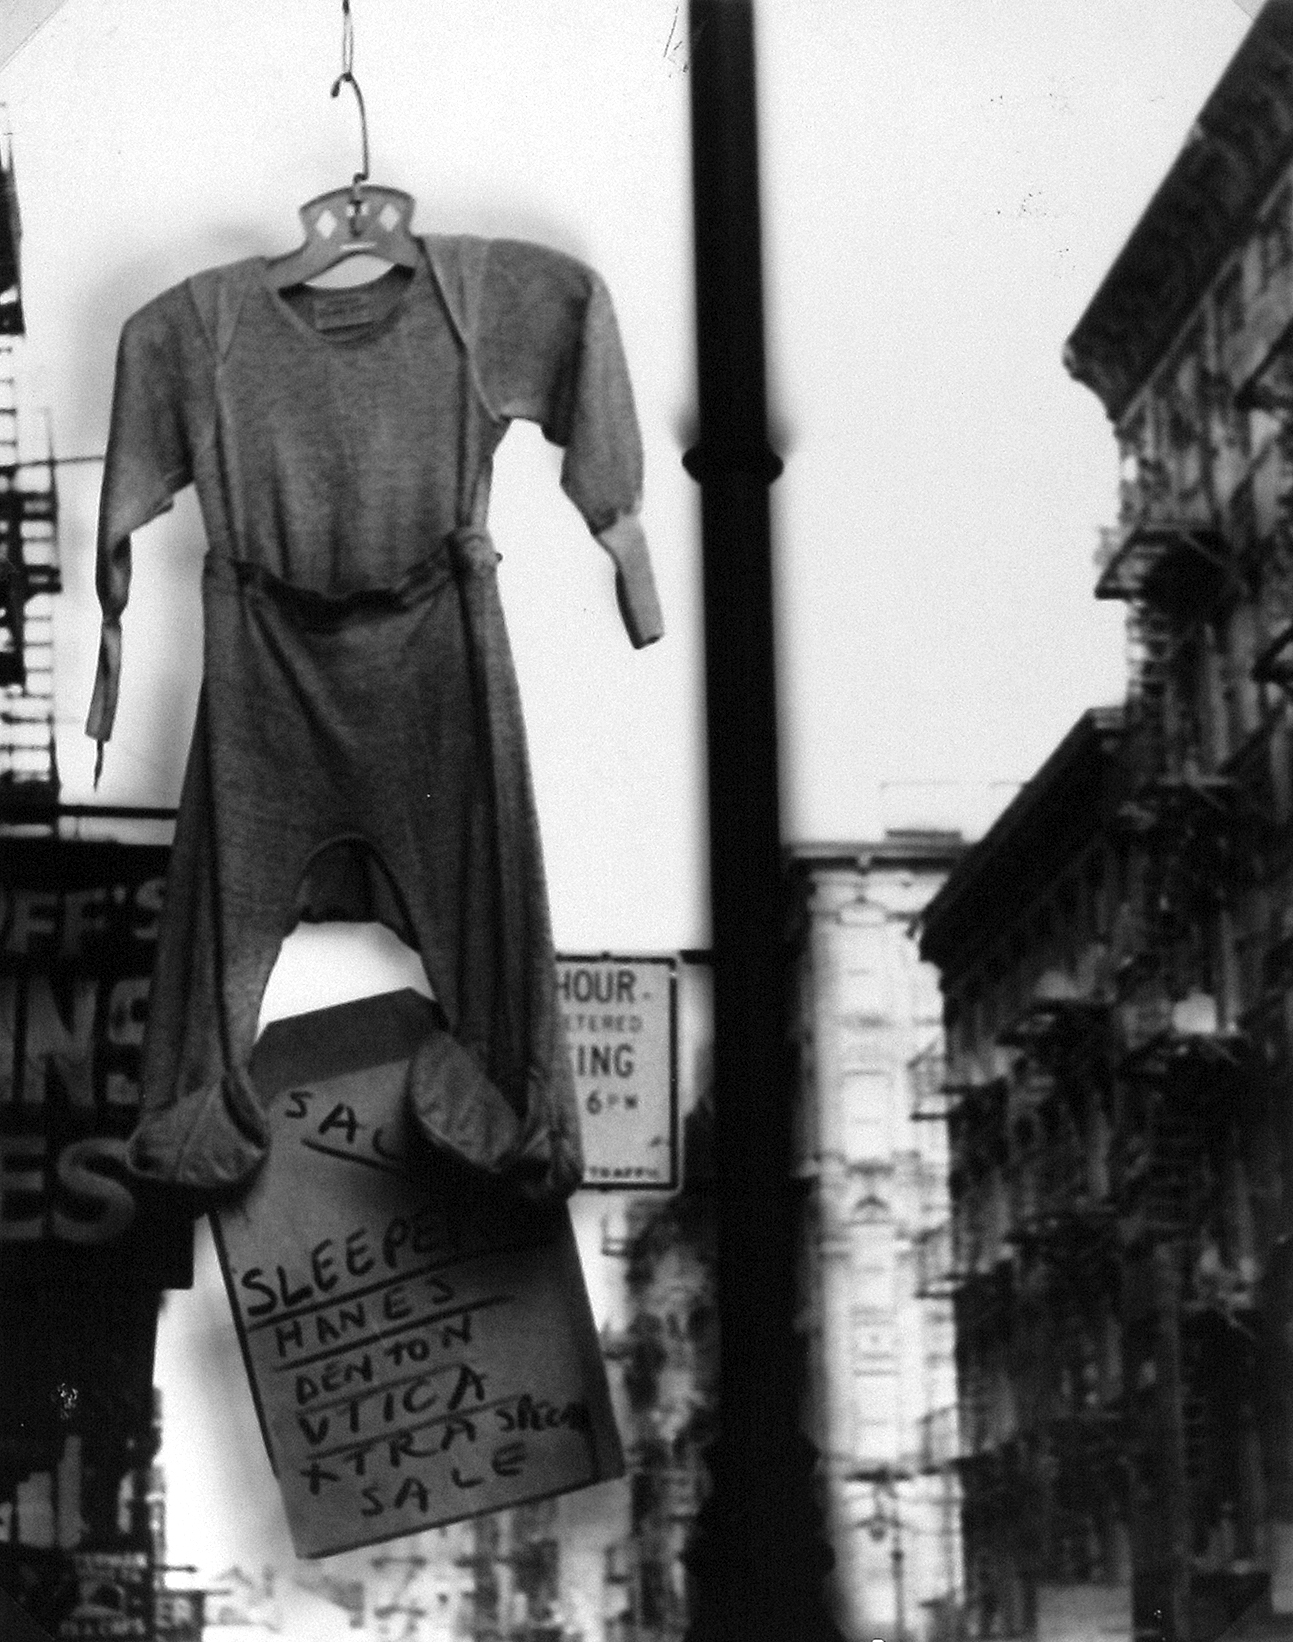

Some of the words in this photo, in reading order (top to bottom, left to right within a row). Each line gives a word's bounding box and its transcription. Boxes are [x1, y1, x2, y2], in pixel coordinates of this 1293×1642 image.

[0, 878, 165, 956] FF'S
[577, 1043, 635, 1079] ING
[275, 1276, 454, 1358] HANES
[361, 1441, 527, 1517] SALE
